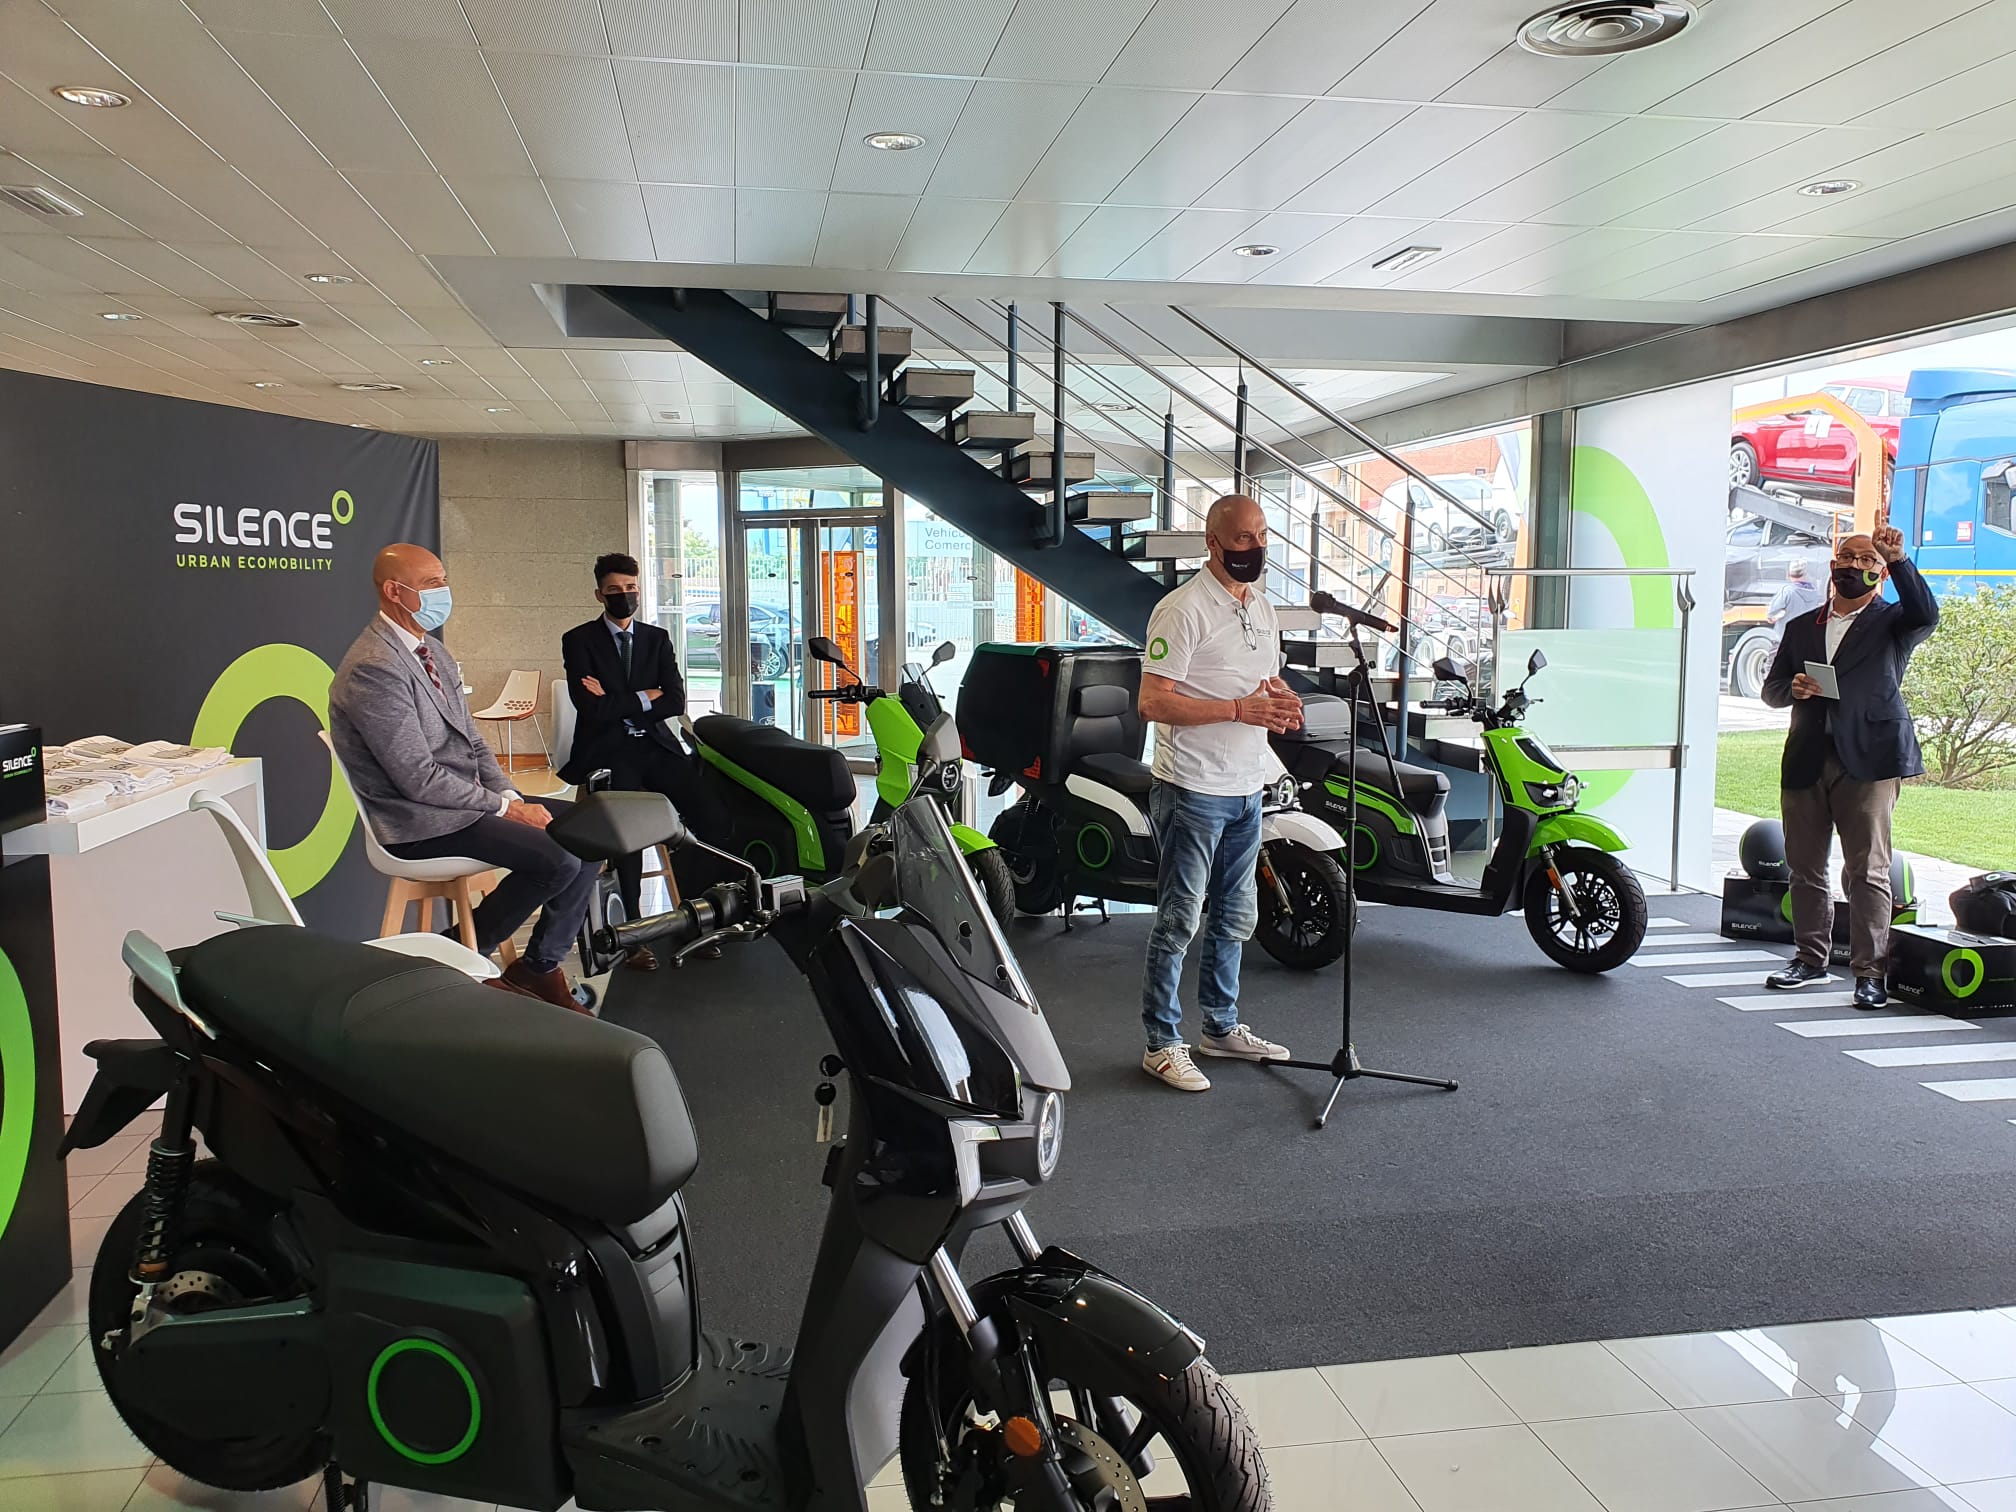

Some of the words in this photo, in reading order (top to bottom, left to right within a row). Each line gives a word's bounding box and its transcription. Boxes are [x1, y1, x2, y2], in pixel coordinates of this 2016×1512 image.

[173, 502, 334, 550] SILENCE
[176, 553, 231, 568] URBAN
[237, 555, 333, 571] ECOMOBILITY
[2, 754, 33, 773] SILENCE
